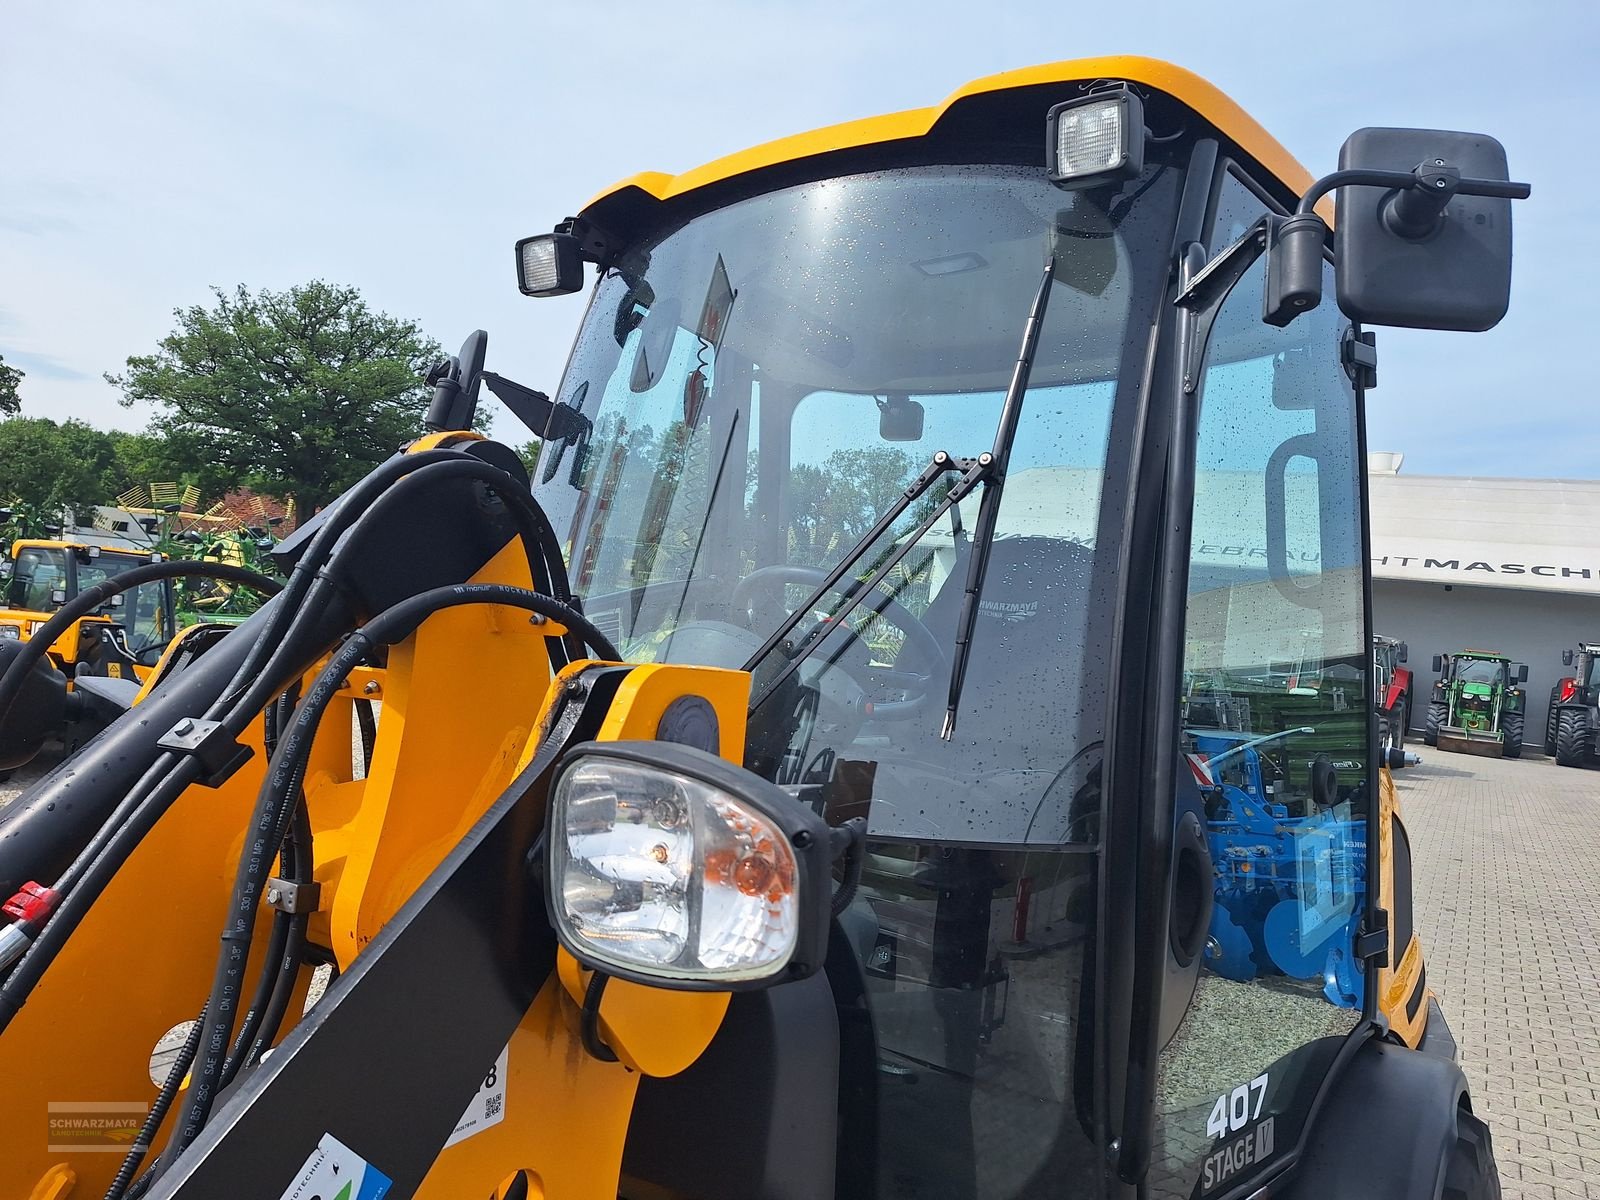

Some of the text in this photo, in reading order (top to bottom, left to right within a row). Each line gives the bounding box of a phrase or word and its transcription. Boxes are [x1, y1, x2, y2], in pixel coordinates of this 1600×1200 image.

[340, 645, 358, 663] FRAS
[259, 812, 272, 831] 4780
[253, 838, 265, 857] MPa
[249, 857, 261, 873] 33.0
[246, 881, 255, 894] bar
[240, 896, 250, 911] 330
[235, 918, 247, 932] WP
[223, 985, 234, 995] 10
[220, 998, 231, 1011] DN
[210, 1023, 226, 1055] 100R16
[204, 1057, 218, 1075] SAE
[197, 1083, 210, 1102] 2SC
[1206, 1073, 1268, 1139] 407
[184, 1124, 197, 1137] EN
[1204, 1133, 1254, 1189] STAGE
